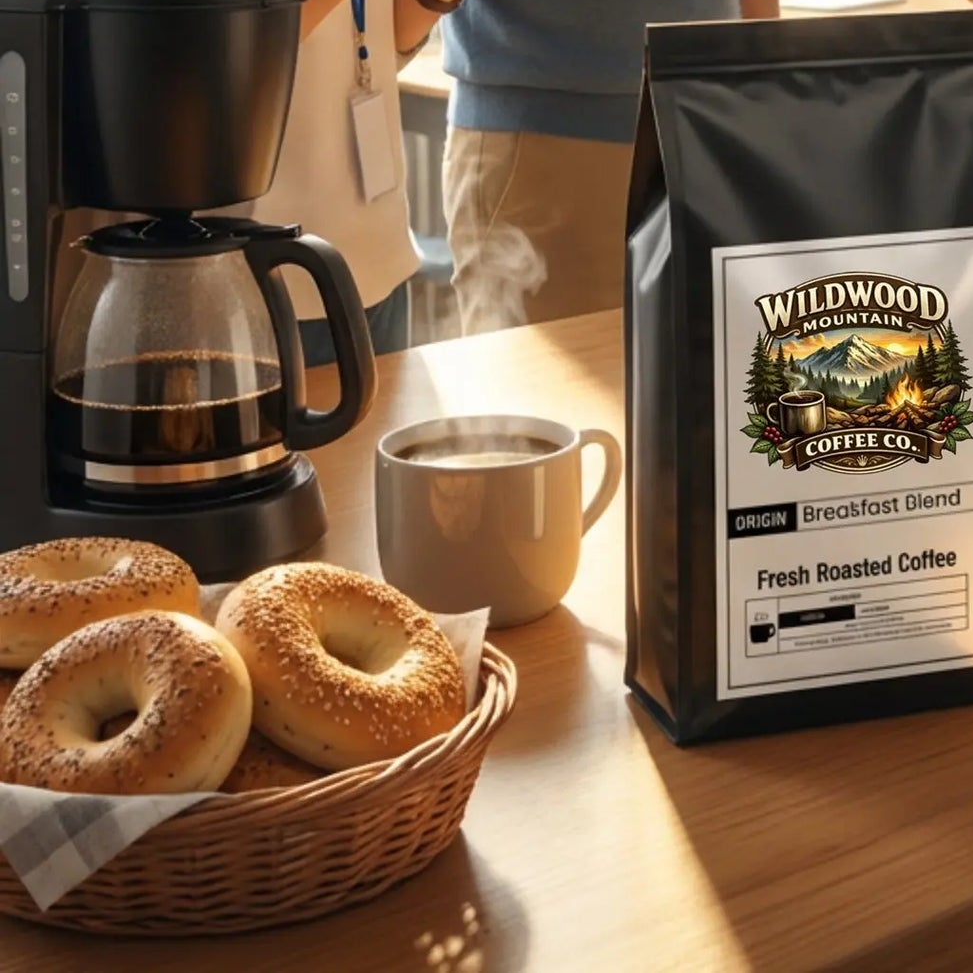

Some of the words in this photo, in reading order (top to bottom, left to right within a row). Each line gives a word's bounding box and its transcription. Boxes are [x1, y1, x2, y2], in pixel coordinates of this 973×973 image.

[758, 280, 946, 332] WILDWOOD
[803, 312, 903, 333] MOUNTAIN
[805, 432, 878, 456] COFFEE
[735, 511, 787, 531] ORIGIN
[905, 488, 961, 511] Blend
[757, 566, 810, 590] Fresh
[817, 555, 892, 583] Roasted
[899, 548, 957, 572] Coffee
